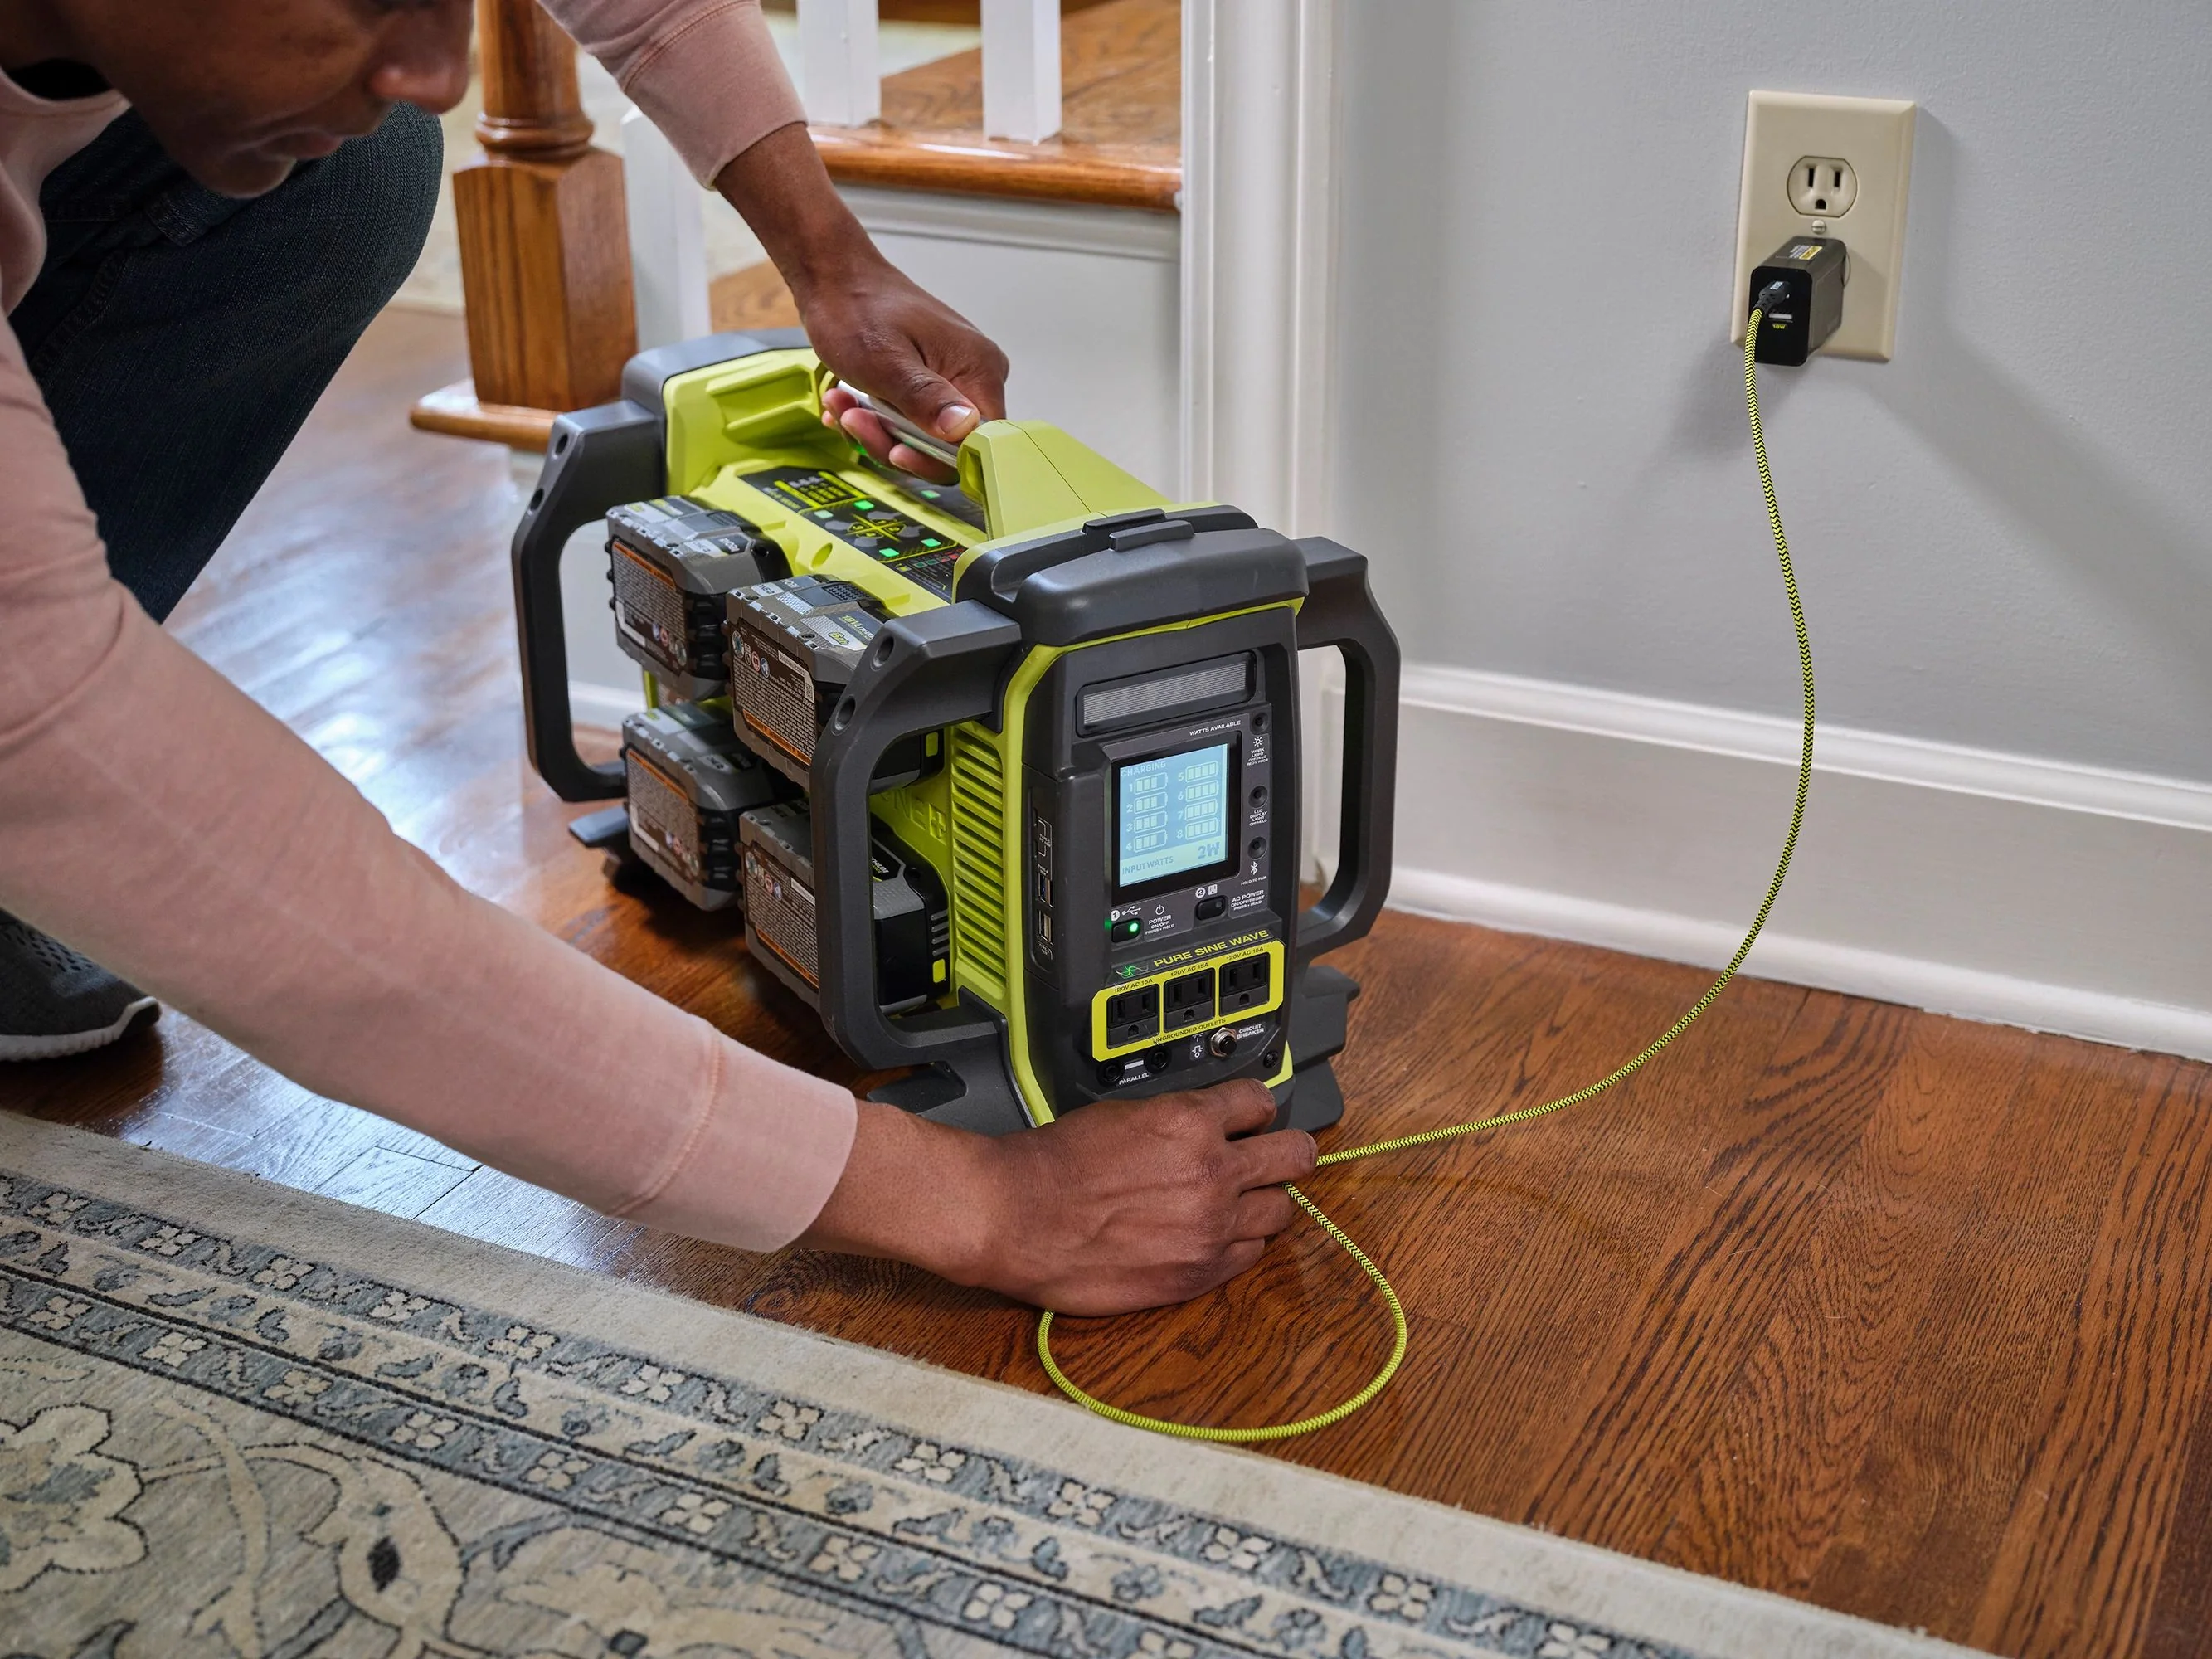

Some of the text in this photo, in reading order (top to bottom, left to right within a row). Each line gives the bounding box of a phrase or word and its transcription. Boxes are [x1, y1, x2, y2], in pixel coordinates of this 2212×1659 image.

[1189, 720, 1241, 736] WATTS AVAILABLE
[1121, 761, 1166, 777] CHARGING
[1179, 772, 1184, 781] 5
[1129, 783, 1133, 793] 1
[1178, 792, 1184, 800] 6
[1126, 804, 1133, 813] 2
[1178, 810, 1184, 820] 7
[1249, 810, 1267, 819] DISPLAY
[1126, 823, 1133, 832] 3
[1176, 830, 1184, 839] 8
[1125, 843, 1132, 851] 4
[1197, 841, 1220, 859] 2W
[1122, 856, 1174, 875] INPUT WATTS
[1242, 889, 1264, 900] POWER
[1149, 914, 1171, 925] POWER
[1150, 921, 1169, 929] ON/OFF
[1153, 929, 1269, 967] PURE SINE WAVE
[1226, 952, 1242, 961] 120V
[1252, 946, 1264, 955] 15A
[1170, 967, 1186, 976] 120V
[1198, 962, 1209, 971] 15A
[1114, 978, 1154, 993] 120V AC 15A
[1153, 1019, 1226, 1044] UNGROUNDED OUTLETS
[1237, 1027, 1265, 1039] BREAKER
[1238, 1023, 1262, 1034] CIRCUIT
[1119, 1073, 1150, 1086] PARALLEL
